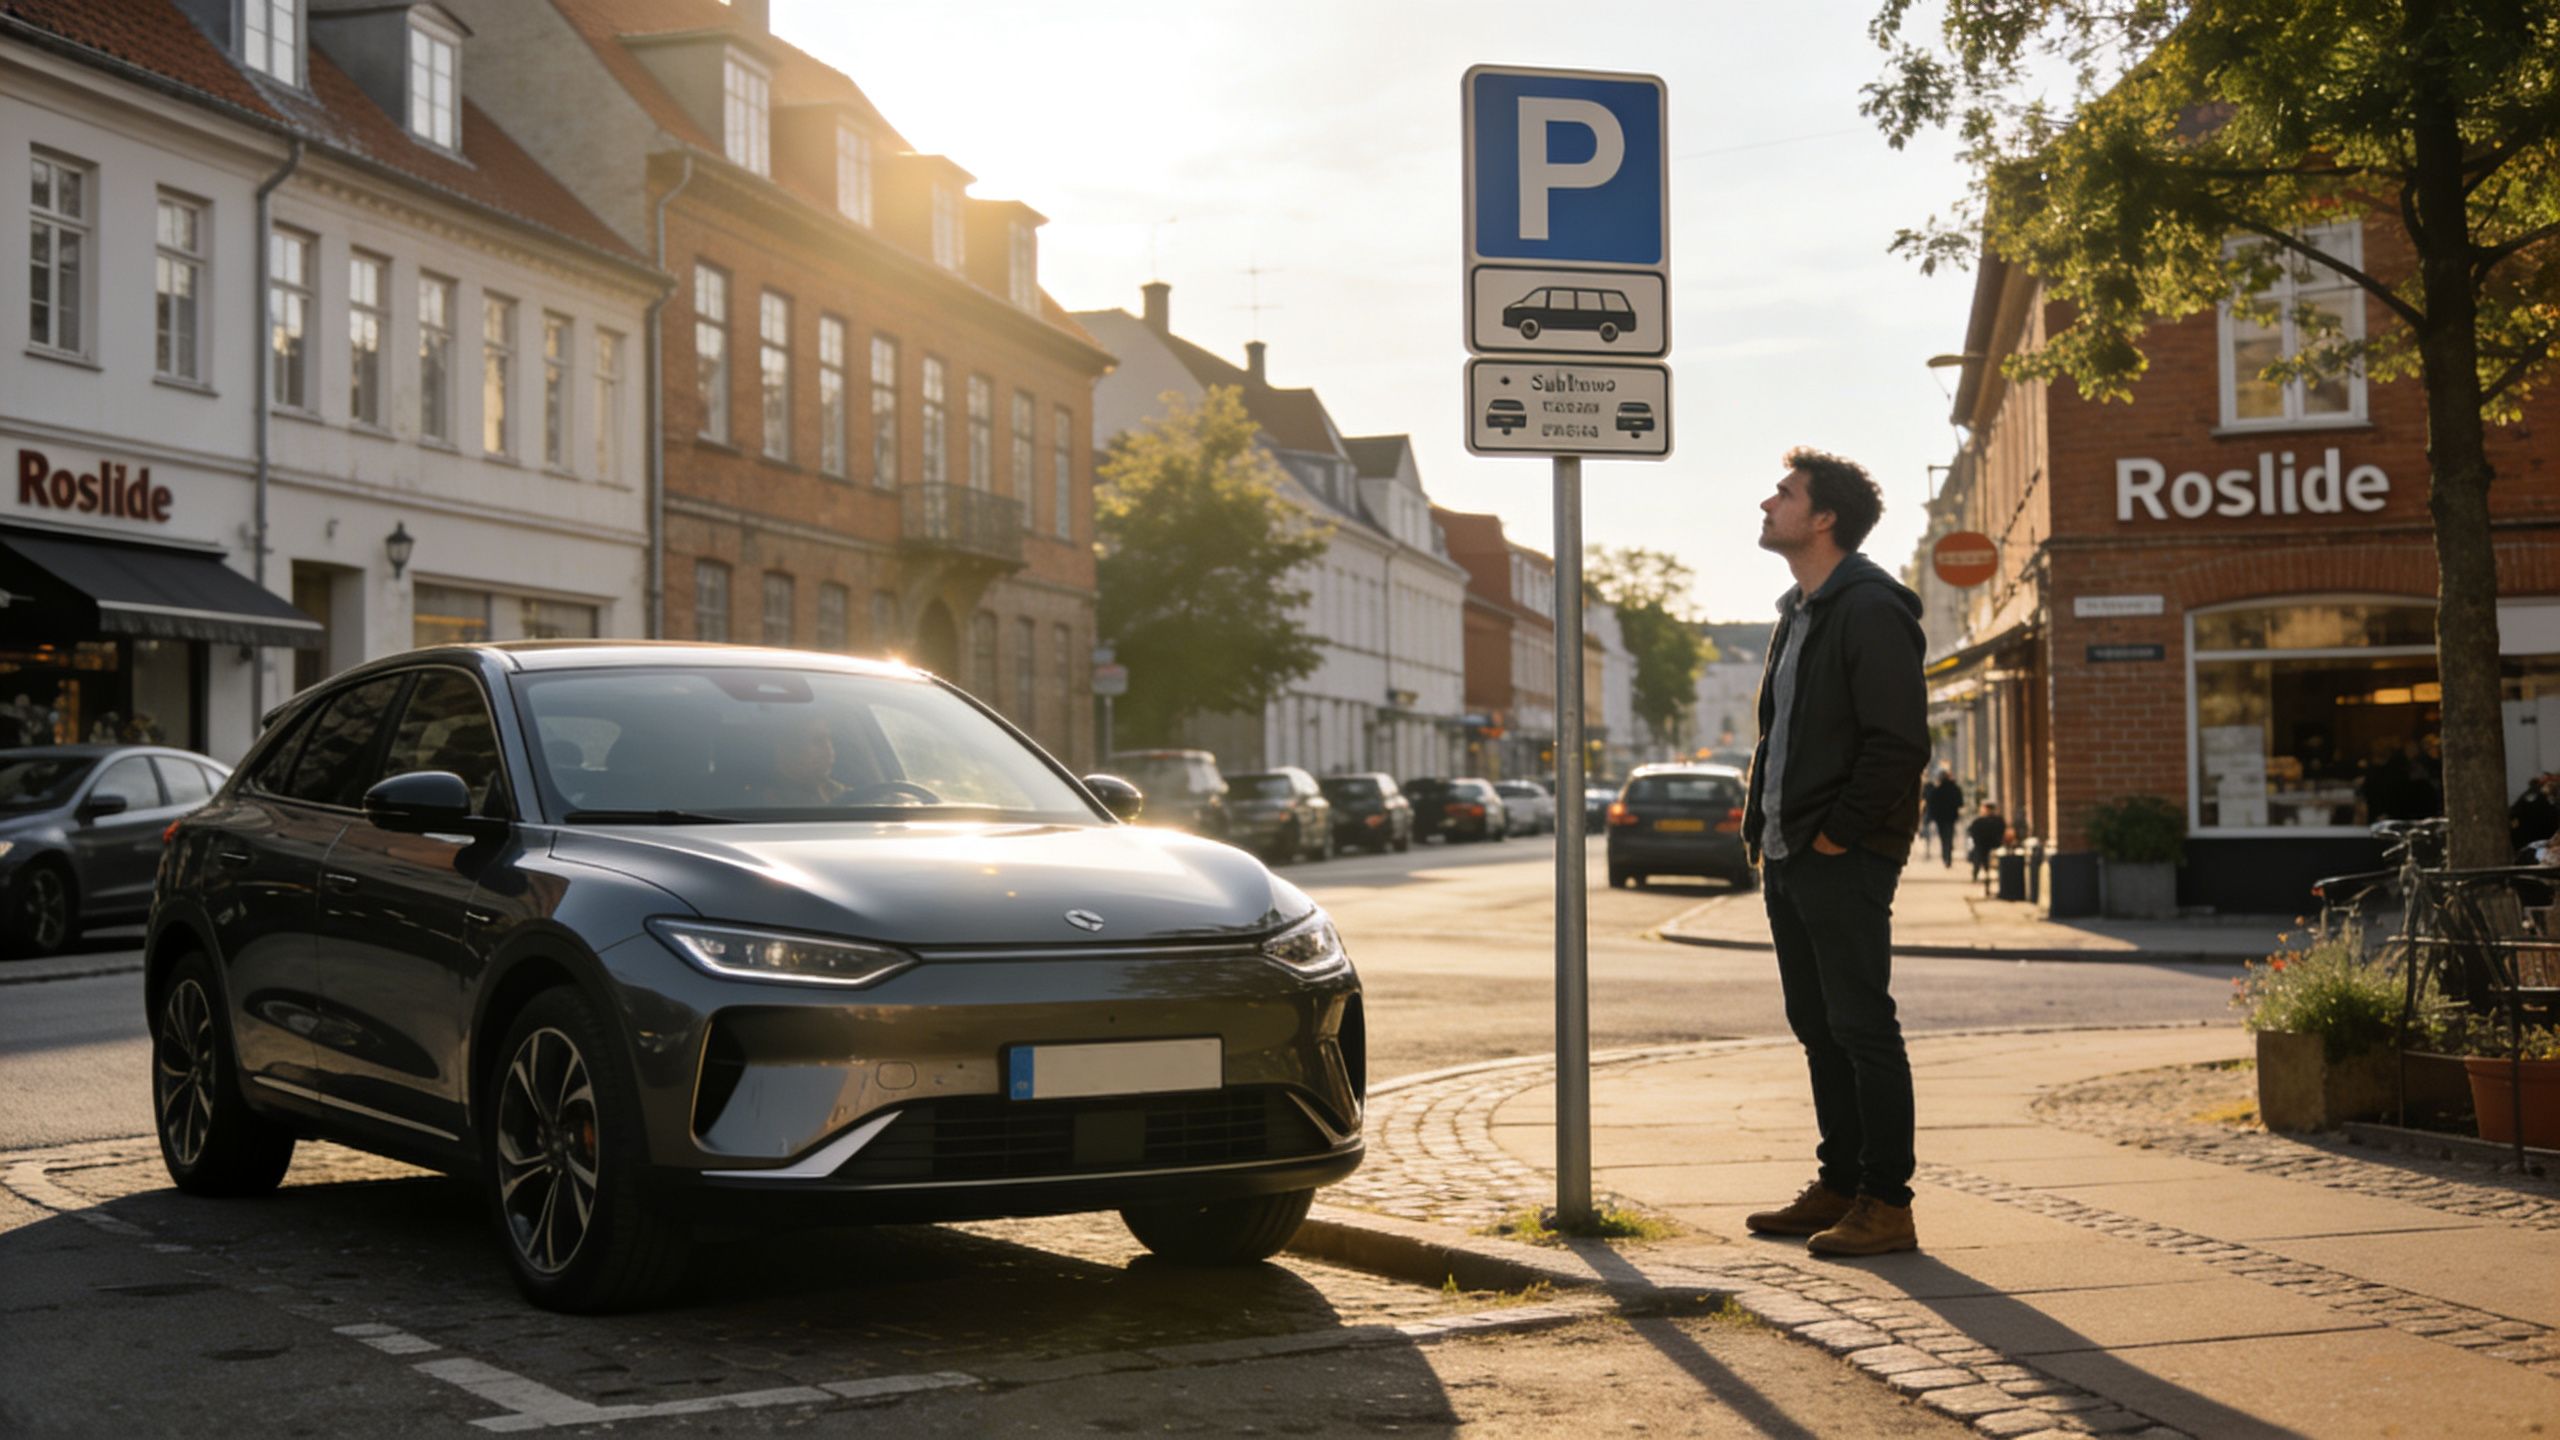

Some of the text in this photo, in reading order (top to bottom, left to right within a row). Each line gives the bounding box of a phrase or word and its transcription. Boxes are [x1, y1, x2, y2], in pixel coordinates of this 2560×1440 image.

[1518, 96, 1625, 240] P
[18, 449, 173, 523] Roslide
[2116, 448, 2390, 521] Roslide
